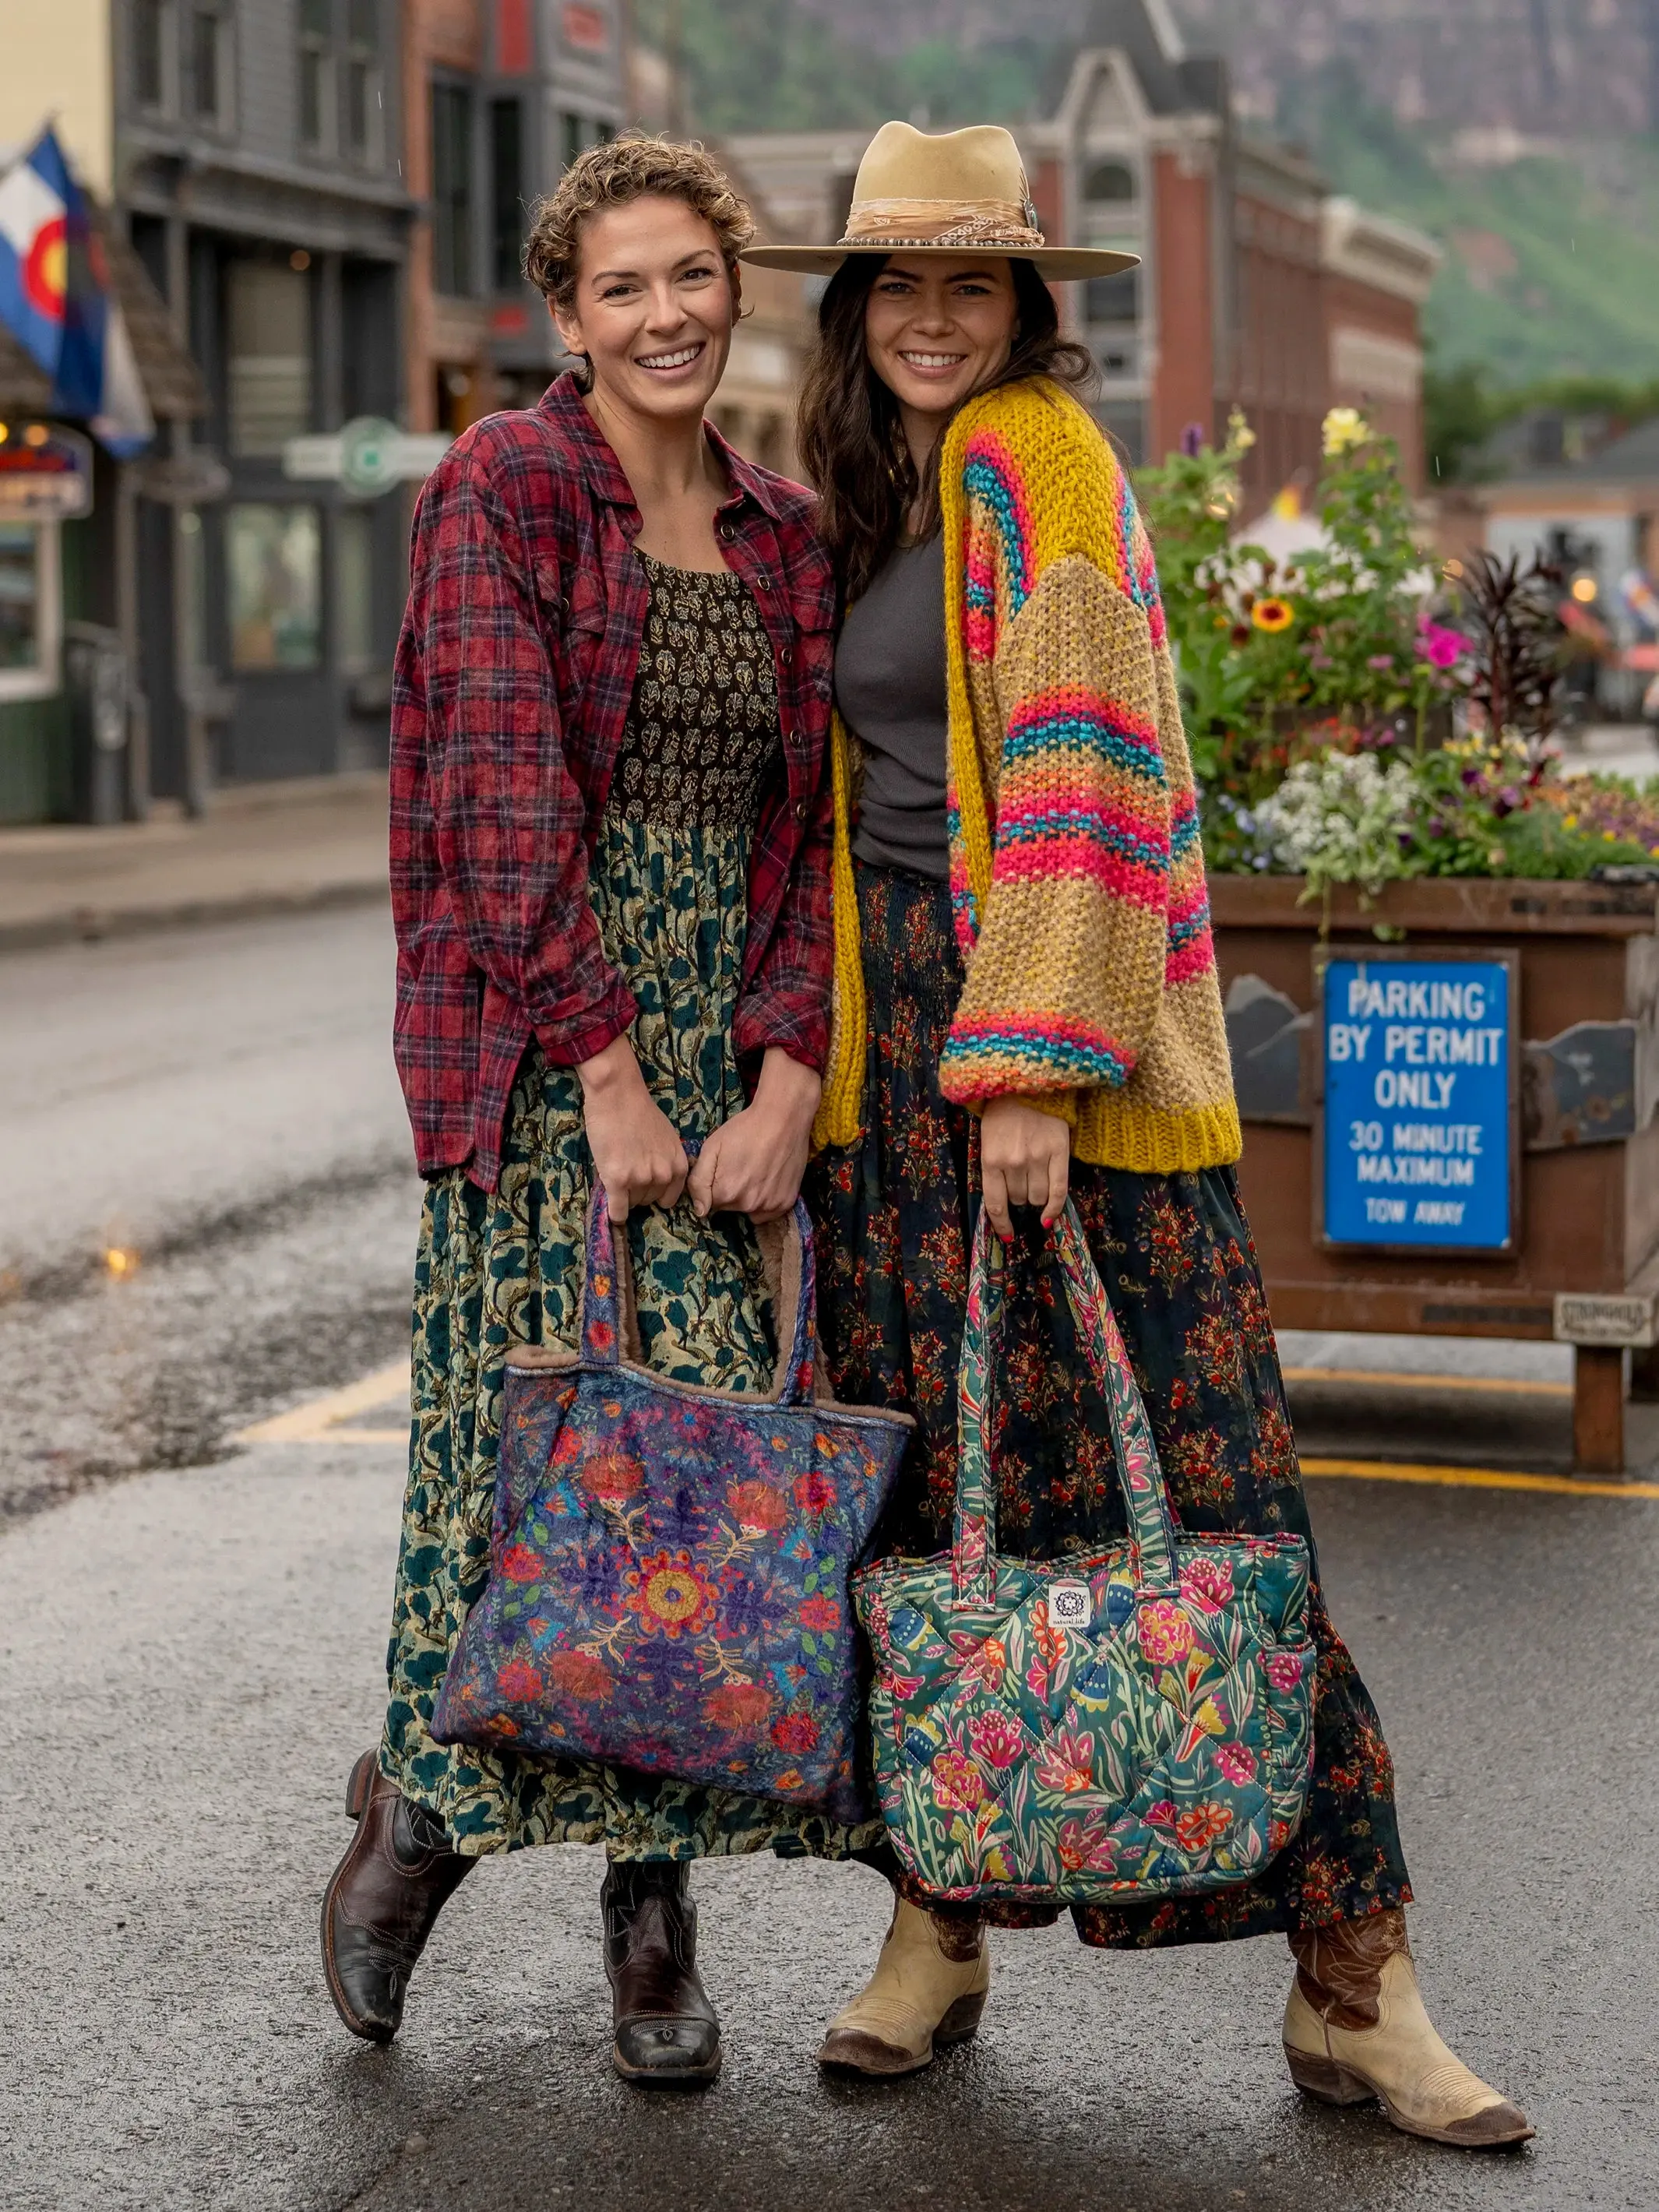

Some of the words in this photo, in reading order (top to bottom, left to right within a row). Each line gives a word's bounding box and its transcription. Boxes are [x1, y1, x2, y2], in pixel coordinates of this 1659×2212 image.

[1349, 980, 1484, 1020] PARKING
[1329, 1024, 1371, 1061] BY
[1386, 1027, 1502, 1065] PERMIT
[1375, 1070, 1455, 1108] ONLY
[1350, 1122, 1382, 1150] 30
[1393, 1124, 1481, 1154] MINUTE
[1358, 1155, 1473, 1185] MAXIMUM
[1366, 1199, 1406, 1222] TOW
[1414, 1202, 1464, 1224] AWAY
